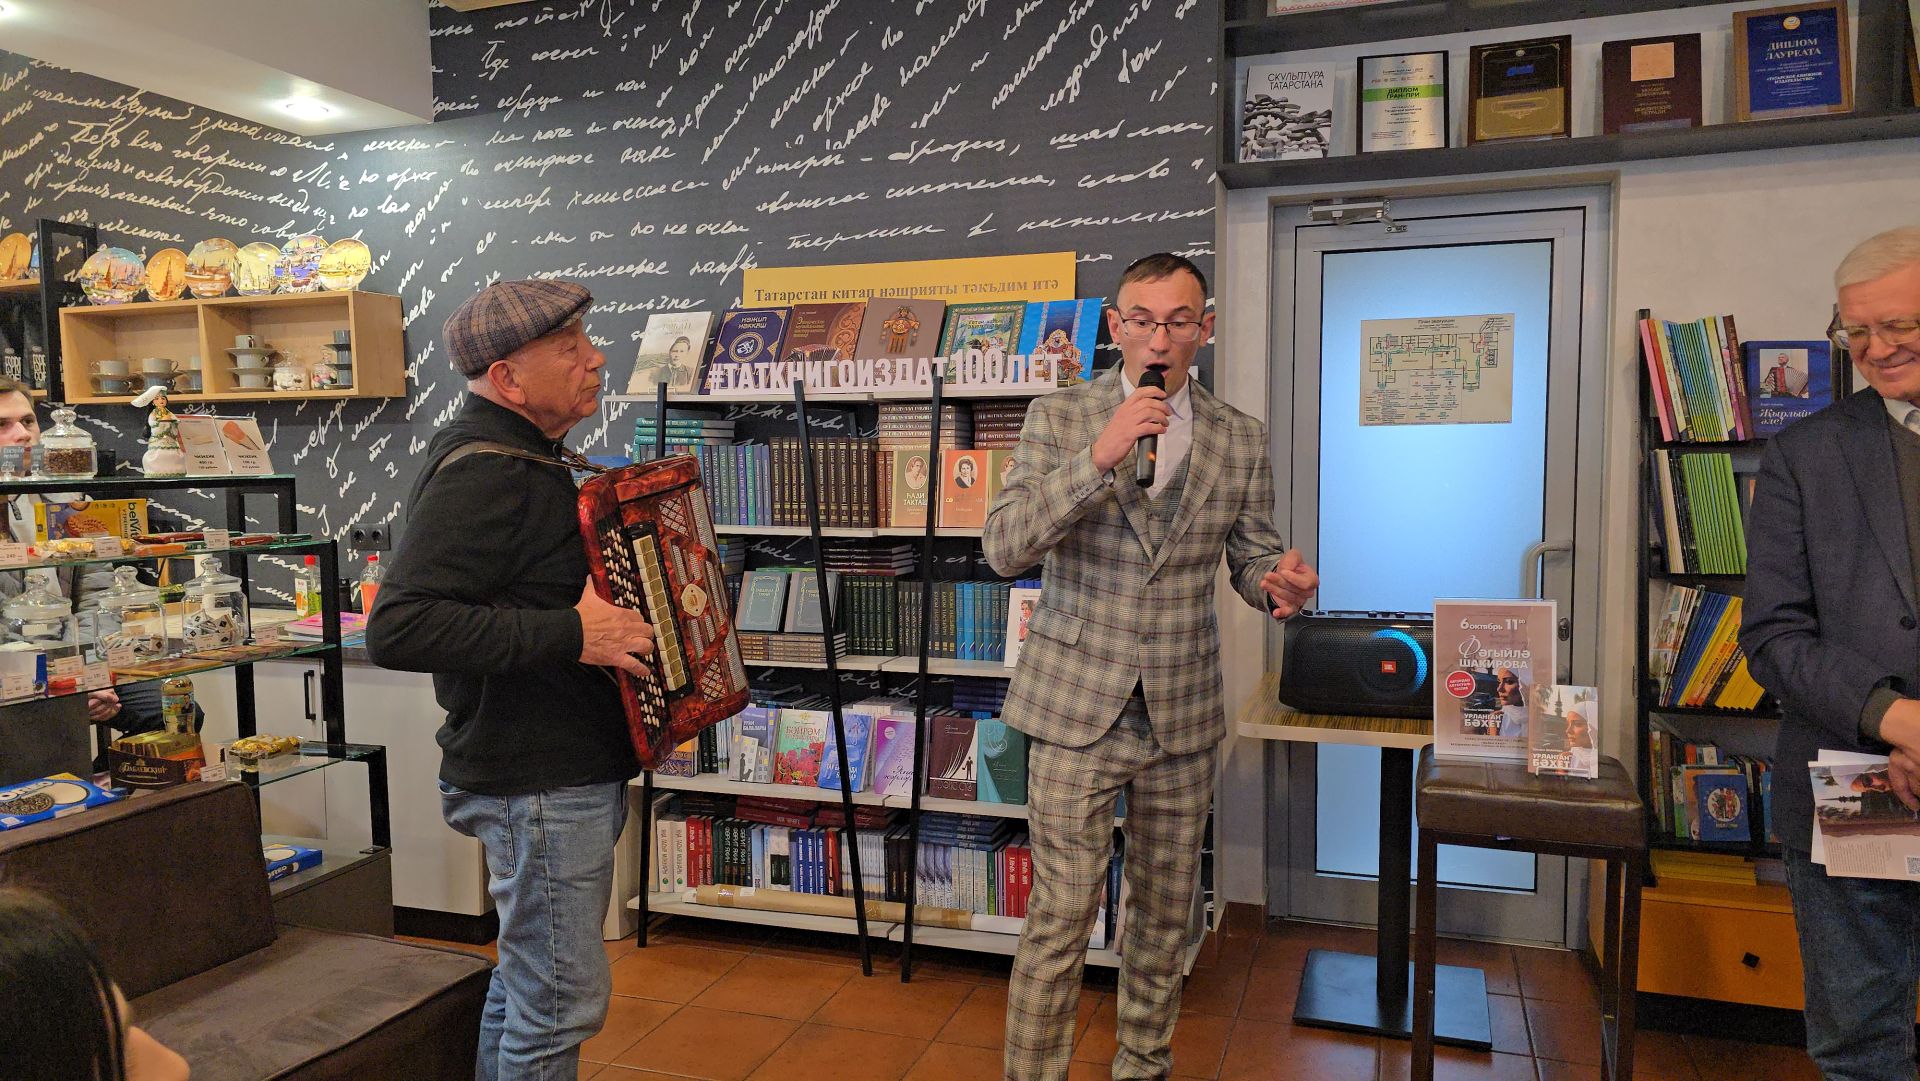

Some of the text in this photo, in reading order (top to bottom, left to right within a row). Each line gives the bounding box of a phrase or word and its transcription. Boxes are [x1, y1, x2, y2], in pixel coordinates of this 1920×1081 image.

[1768, 38, 1818, 51] ДИПЛОМ
[1764, 47, 1822, 60] ЛАУРЕАТА
[1267, 70, 1325, 82] СКУЛЬПТУРА
[1269, 79, 1324, 90] ТАТАРСТАНА
[754, 279, 1059, 304] Татарстан китап нәшрияты тәкъдим итә
[709, 354, 949, 392] #ТАТКНИГОИЗДАТ
[1460, 618, 1470, 630] 6
[1469, 622, 1504, 632] октябрь
[1458, 634, 1531, 659] Фәгыйлә
[1459, 658, 1528, 669] ШАКИРОВА
[1464, 719, 1502, 728] БӘХЕТ
[1532, 753, 1571, 761] УРЛАНГАН
[1532, 758, 1570, 768] БӘХЕТ
